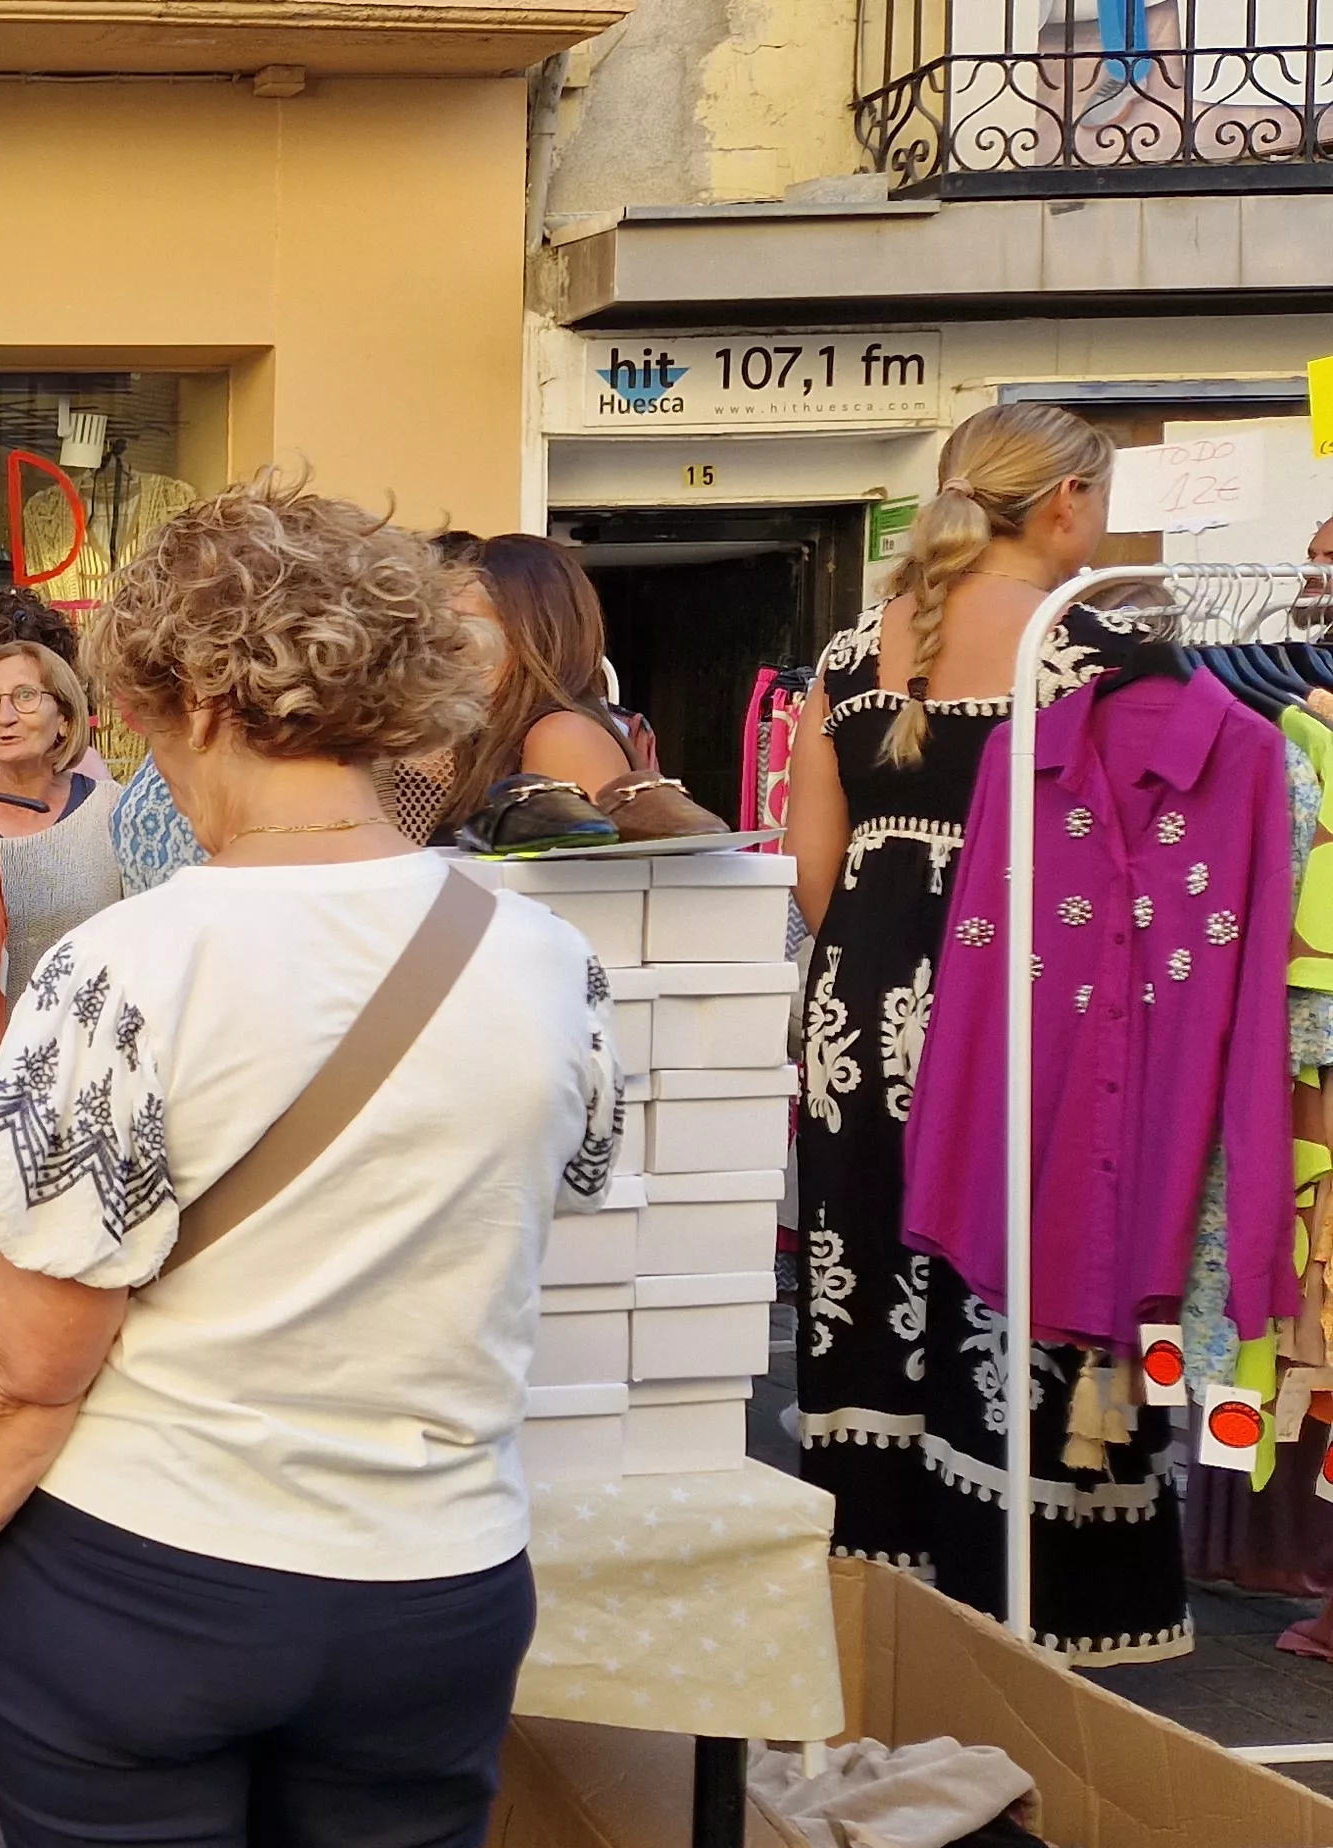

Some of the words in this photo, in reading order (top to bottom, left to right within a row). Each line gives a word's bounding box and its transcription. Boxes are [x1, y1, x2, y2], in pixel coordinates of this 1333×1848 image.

[609, 347, 675, 390] hit
[715, 345, 835, 398] 107,1
[861, 343, 926, 388] fm
[599, 393, 684, 415] Huesca
[714, 400, 928, 415] www.hithuesca.com
[1145, 440, 1235, 466] TODO
[686, 465, 714, 486] 15
[1159, 472, 1240, 512] 12€
